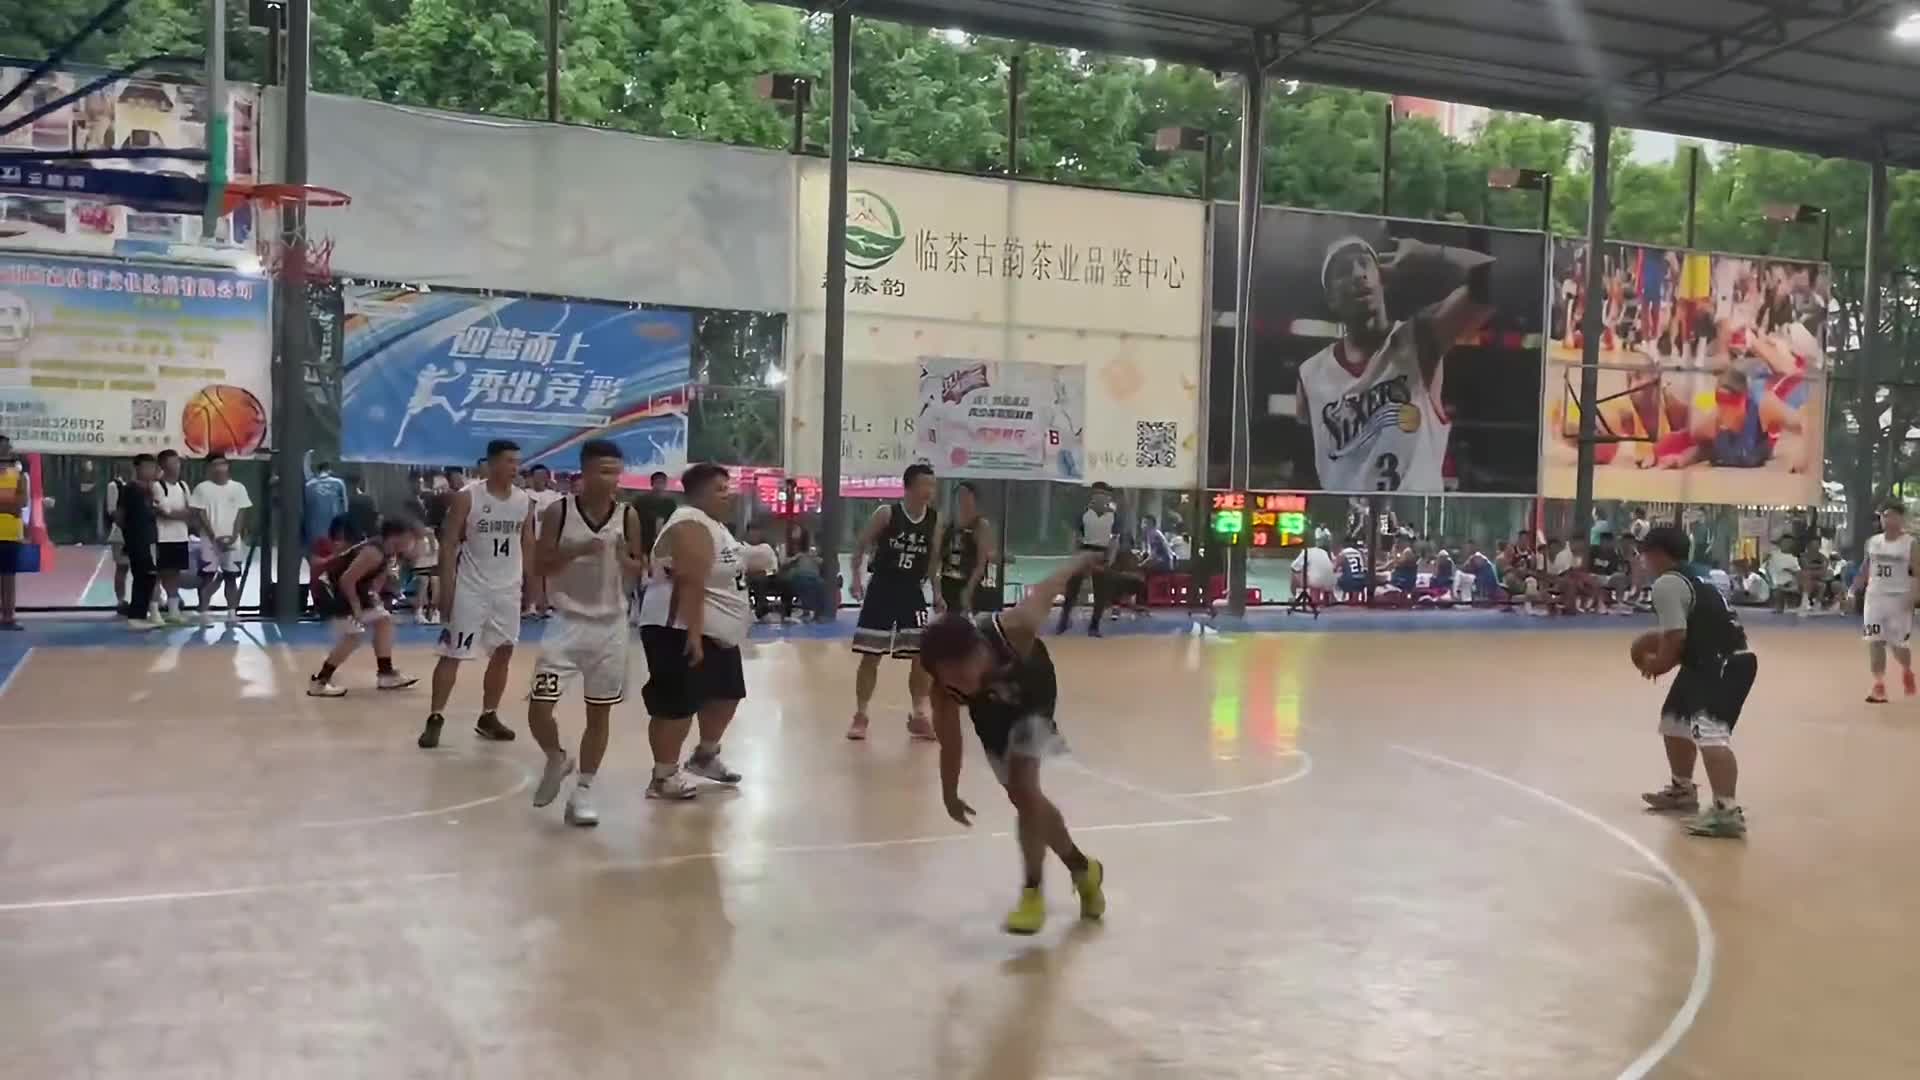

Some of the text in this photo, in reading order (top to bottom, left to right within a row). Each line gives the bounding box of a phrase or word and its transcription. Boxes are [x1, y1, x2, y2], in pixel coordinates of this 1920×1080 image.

[914, 227, 1186, 290] 临茶古韵茶业品鉴中心
[448, 326, 592, 366] 迎篮而上
[493, 538, 510, 557] 14
[898, 553, 916, 569] 15
[457, 632, 475, 650] 14
[535, 673, 559, 693] 23
